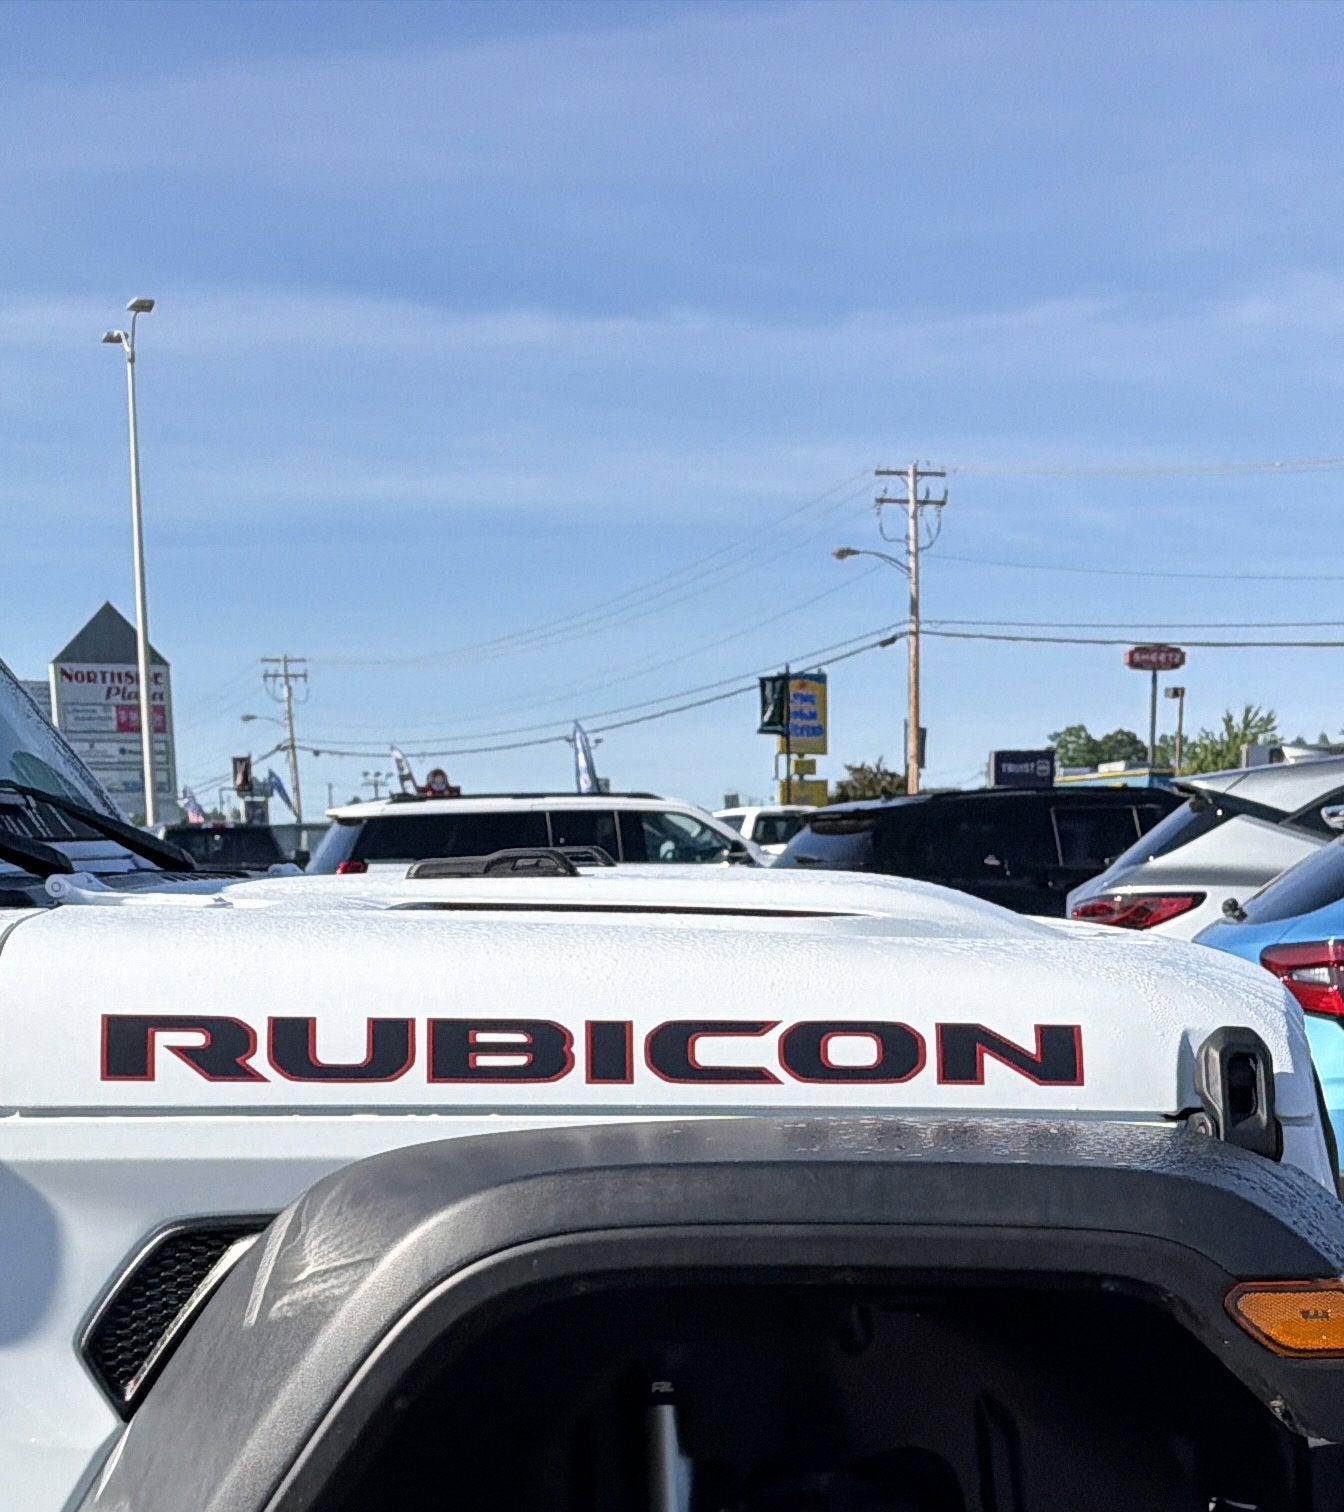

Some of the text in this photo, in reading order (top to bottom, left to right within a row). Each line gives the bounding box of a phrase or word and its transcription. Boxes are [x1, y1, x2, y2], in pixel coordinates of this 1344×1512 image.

[60, 667, 163, 686] NORTHSE
[105, 686, 165, 701] Plaa
[100, 1014, 1084, 1087] RUBICON
